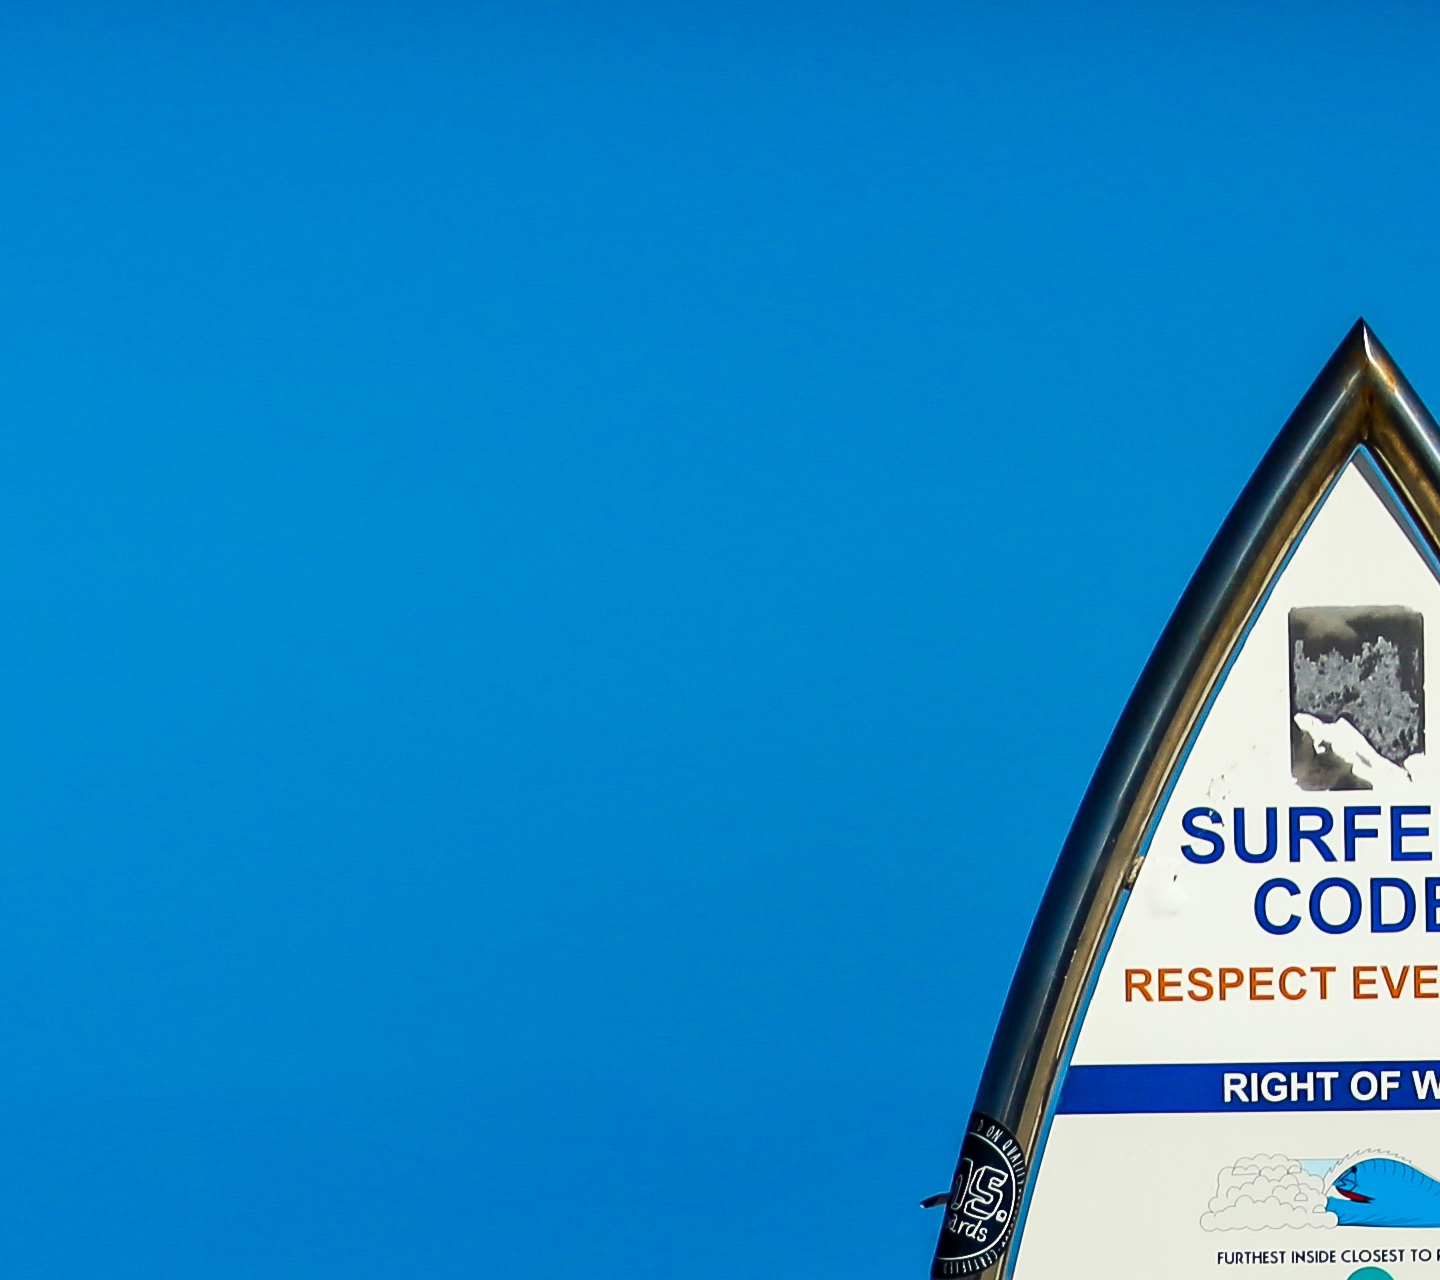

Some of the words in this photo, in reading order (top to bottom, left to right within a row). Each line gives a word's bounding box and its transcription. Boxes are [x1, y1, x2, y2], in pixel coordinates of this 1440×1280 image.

[1124, 966, 1337, 1003] RESPECT
[1223, 1071, 1339, 1103] RIGHT
[1350, 1070, 1401, 1101] OF
[1217, 1250, 1286, 1265] FURTHEST
[1291, 1249, 1337, 1264] INSIDE
[1340, 1249, 1405, 1264] CLOSEST
[1410, 1248, 1432, 1262] TO
